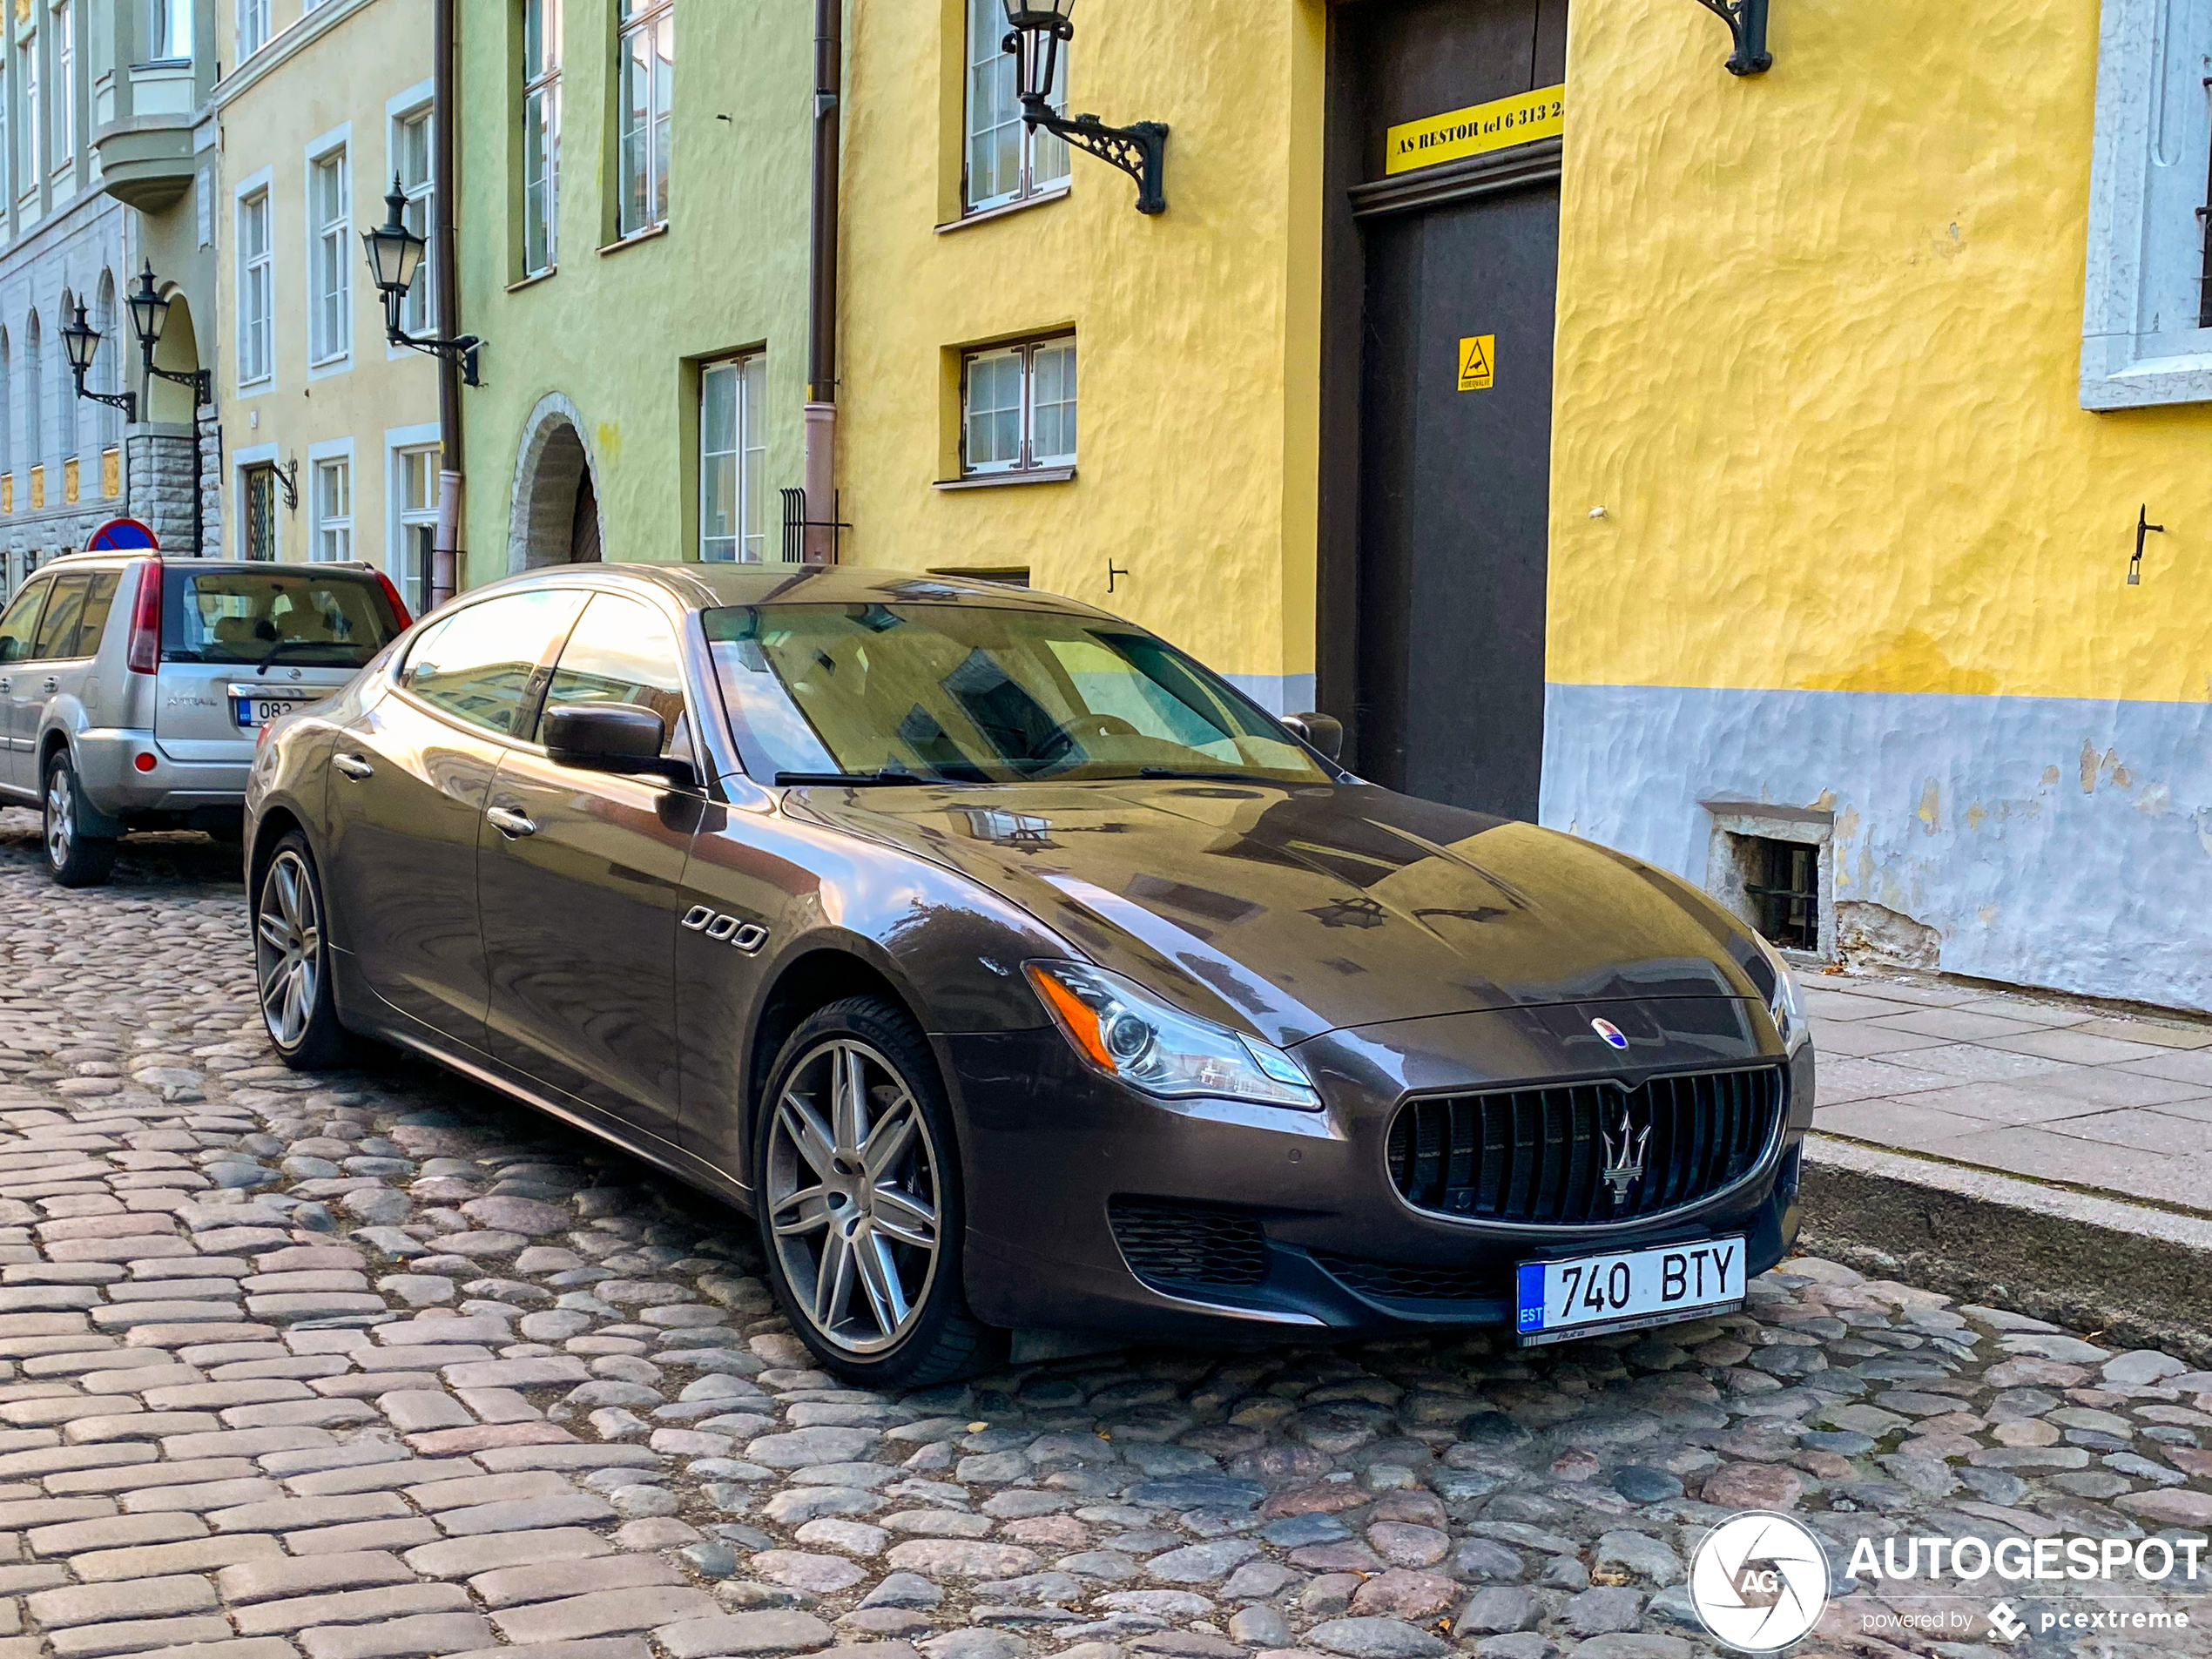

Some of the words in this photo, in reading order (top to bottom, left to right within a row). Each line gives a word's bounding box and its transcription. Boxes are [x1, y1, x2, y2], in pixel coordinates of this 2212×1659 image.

[1397, 138, 1414, 155] AS
[1419, 122, 1479, 150] RESTOR
[1484, 116, 1501, 134] tel
[1506, 112, 1514, 128] 6
[1519, 105, 1546, 125] 313
[1552, 101, 1564, 118] 2
[1521, 1306, 1542, 1324] EST
[1561, 1261, 1630, 1318] 740
[1662, 1245, 1735, 1303] BTY
